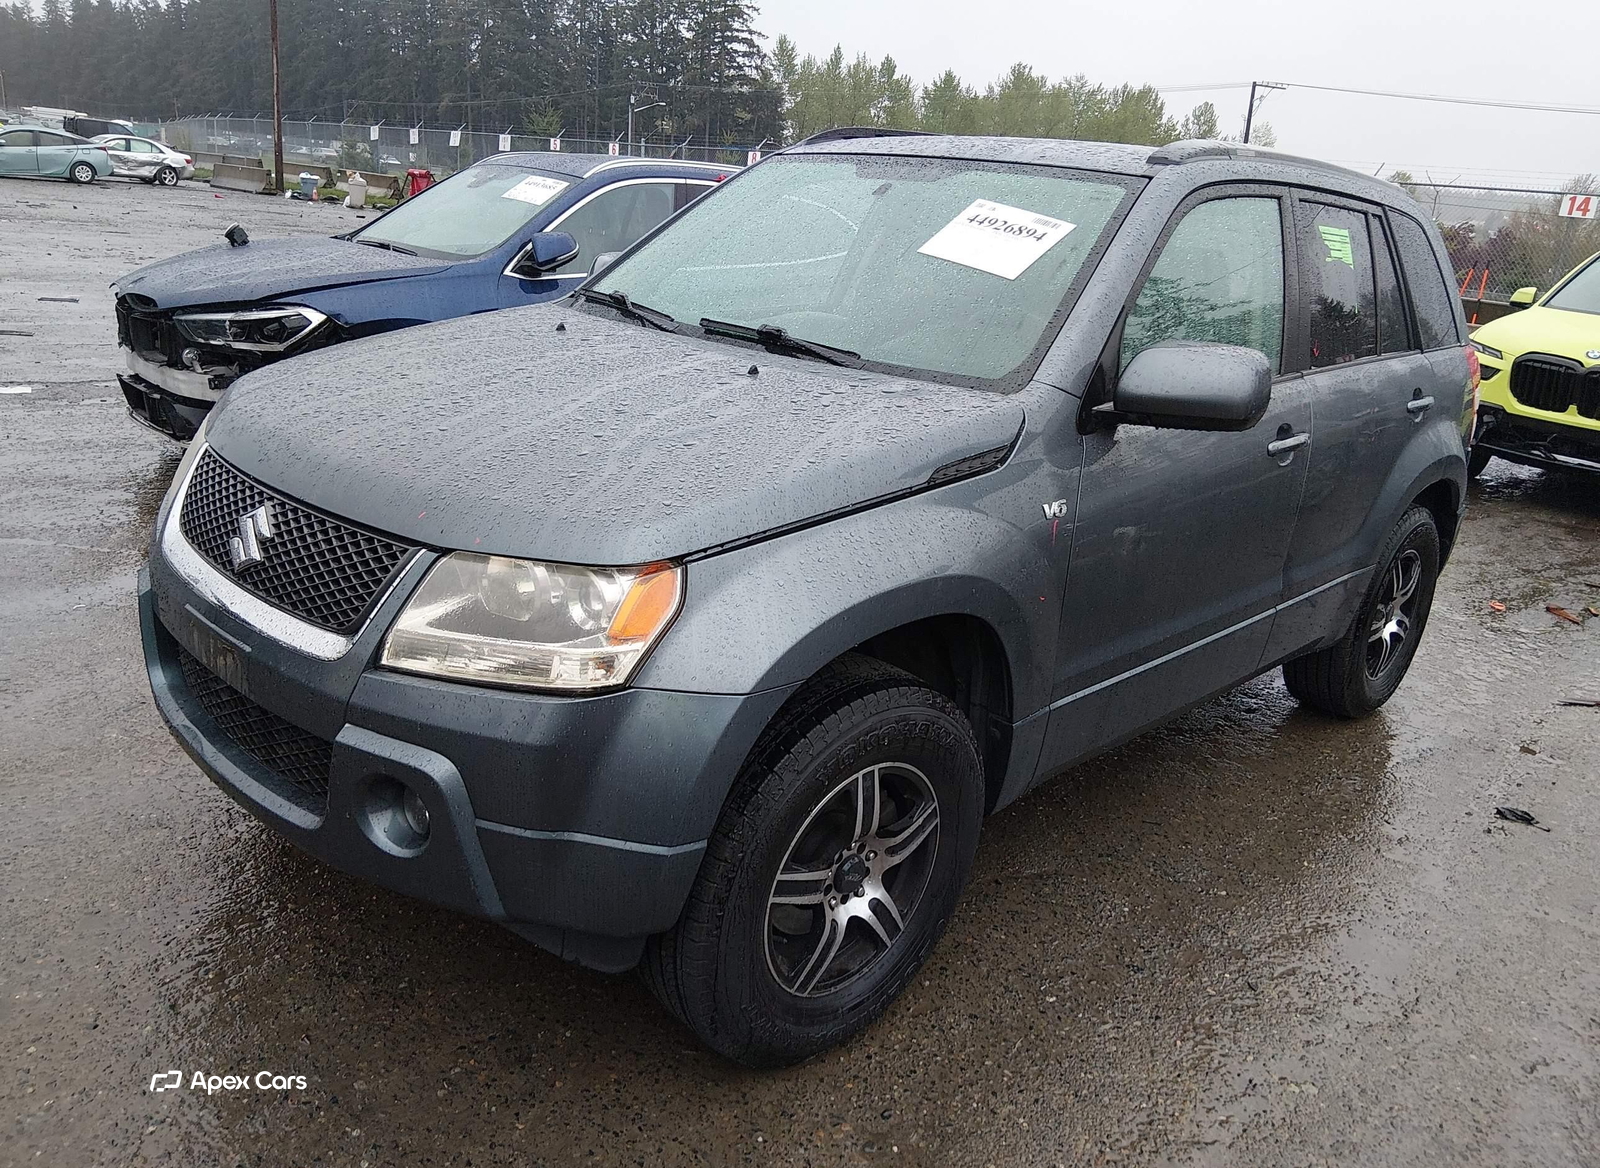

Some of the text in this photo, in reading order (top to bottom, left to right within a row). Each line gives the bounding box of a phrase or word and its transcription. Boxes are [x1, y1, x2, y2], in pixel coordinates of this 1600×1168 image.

[552, 139, 558, 150] 5
[611, 144, 617, 155] 6
[751, 152, 757, 164] 8
[1567, 196, 1591, 216] 14
[966, 213, 1048, 242] 44926894
[1042, 498, 1068, 520] V6
